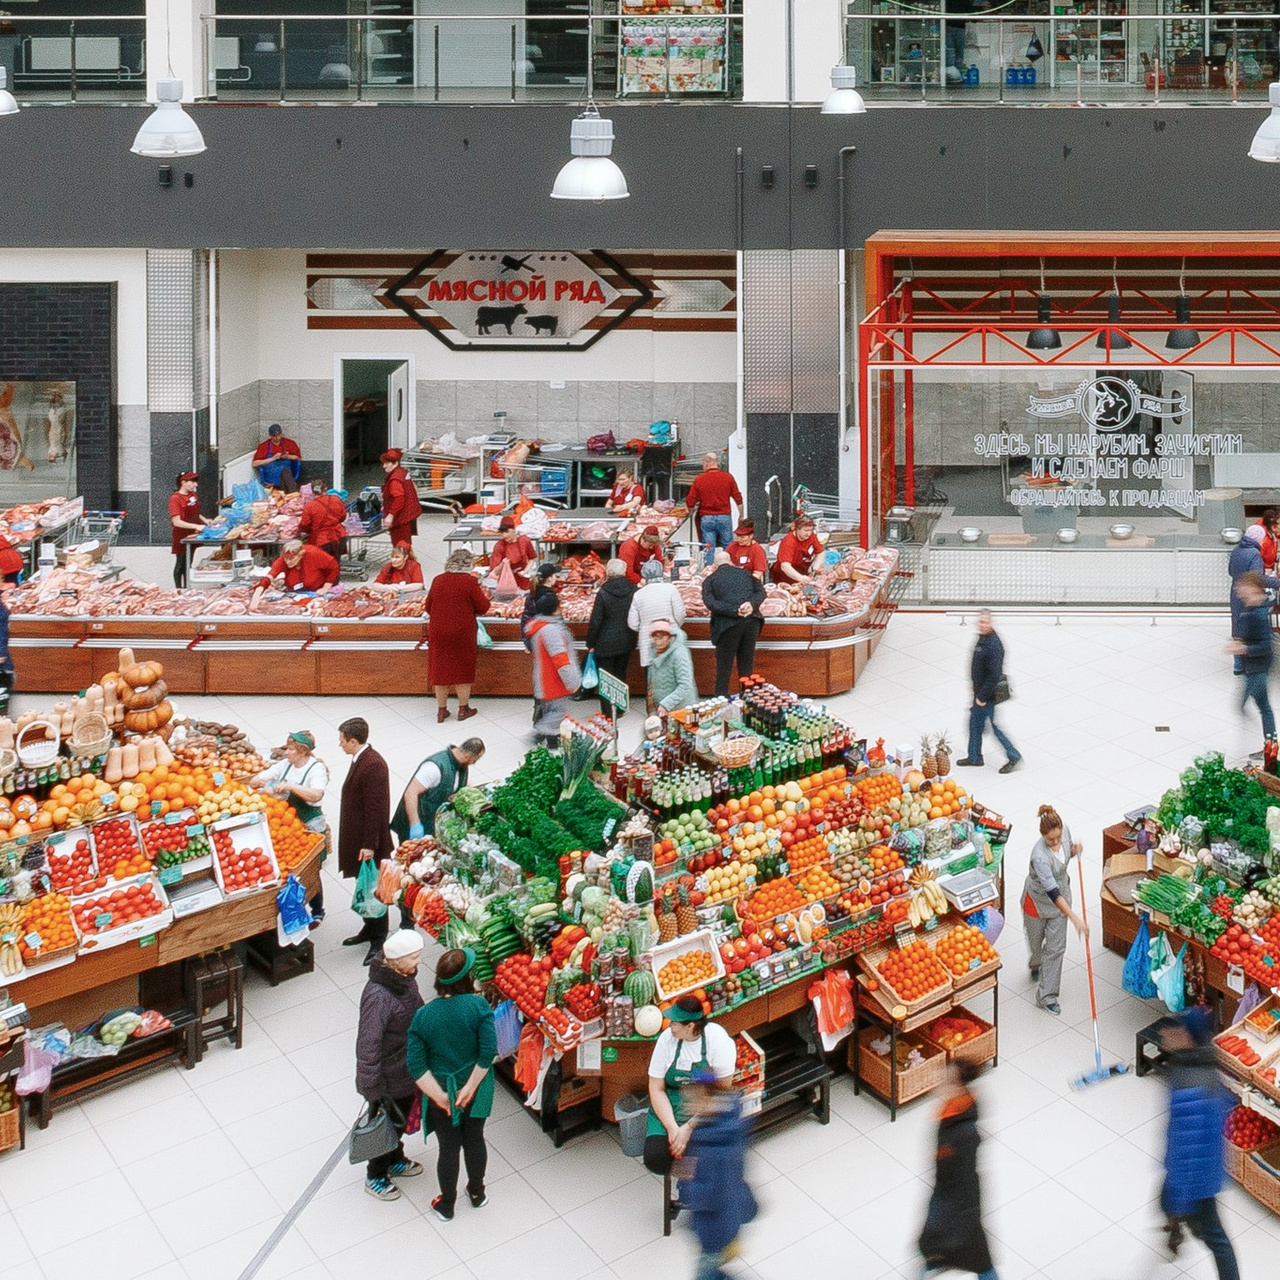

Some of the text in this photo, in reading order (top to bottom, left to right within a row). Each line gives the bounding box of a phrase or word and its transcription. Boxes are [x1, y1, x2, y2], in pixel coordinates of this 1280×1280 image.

[428, 275, 606, 303] МЯСНОЙ РЯД
[974, 433, 1030, 457] ЗДЕСЬ
[1035, 433, 1063, 455] МЫ
[1154, 433, 1243, 455] ЗАЧИСТИМ
[1032, 456, 1186, 481] И СДЕЛАЕМ ФАРШ
[1010, 487, 1206, 508] ОБРАЩАЙТЕСЬ К ПРОДАВЦАМ
